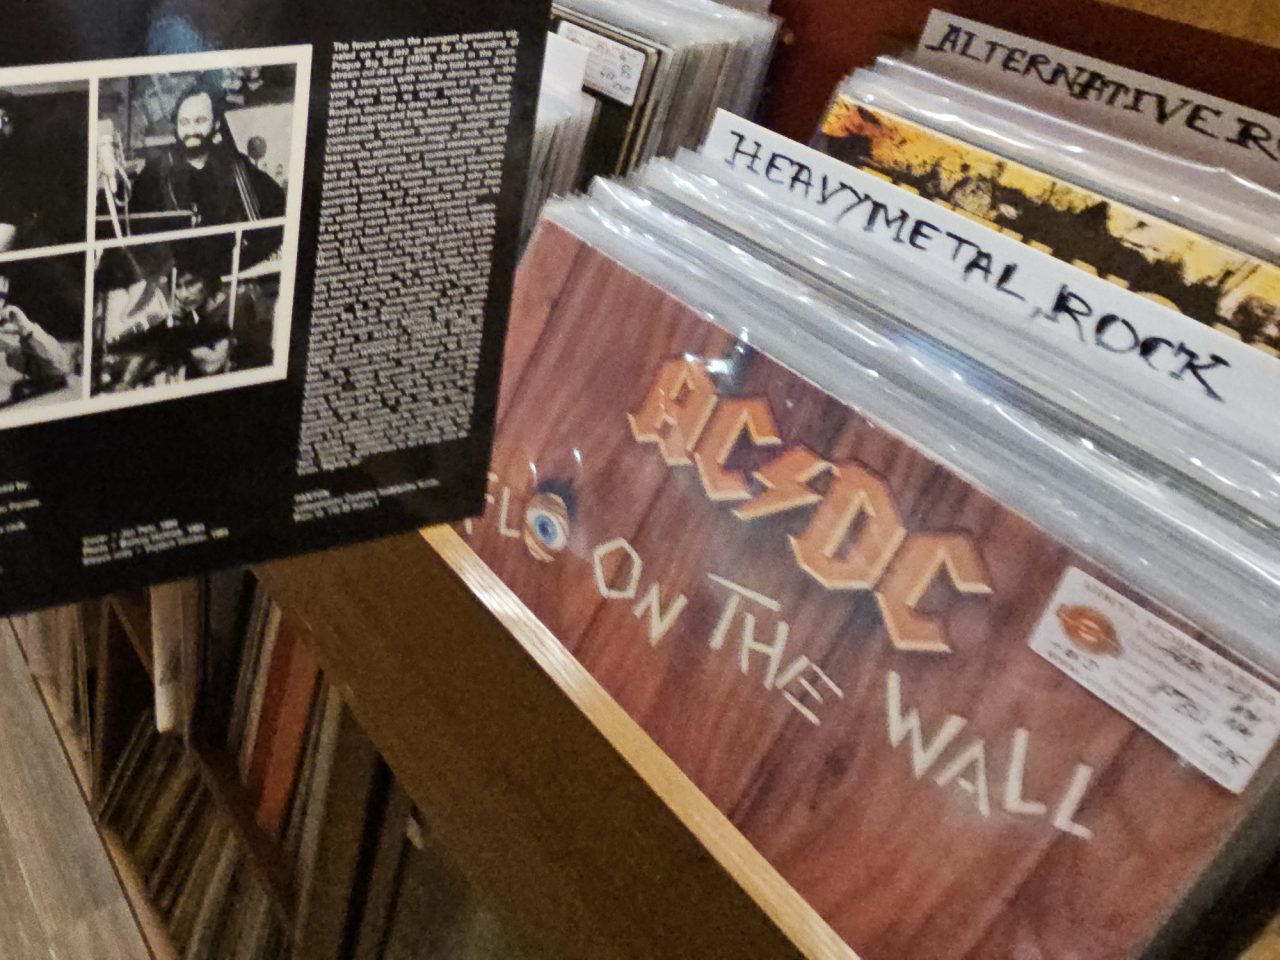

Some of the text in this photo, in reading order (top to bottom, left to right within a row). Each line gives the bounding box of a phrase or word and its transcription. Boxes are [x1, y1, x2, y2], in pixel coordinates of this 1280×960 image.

[924, 22, 1224, 140] ALTERNATIVE
[1031, 283, 1231, 404] ROCK
[591, 537, 688, 647] ON
[708, 572, 844, 726] THE
[885, 669, 1096, 839] WALL
